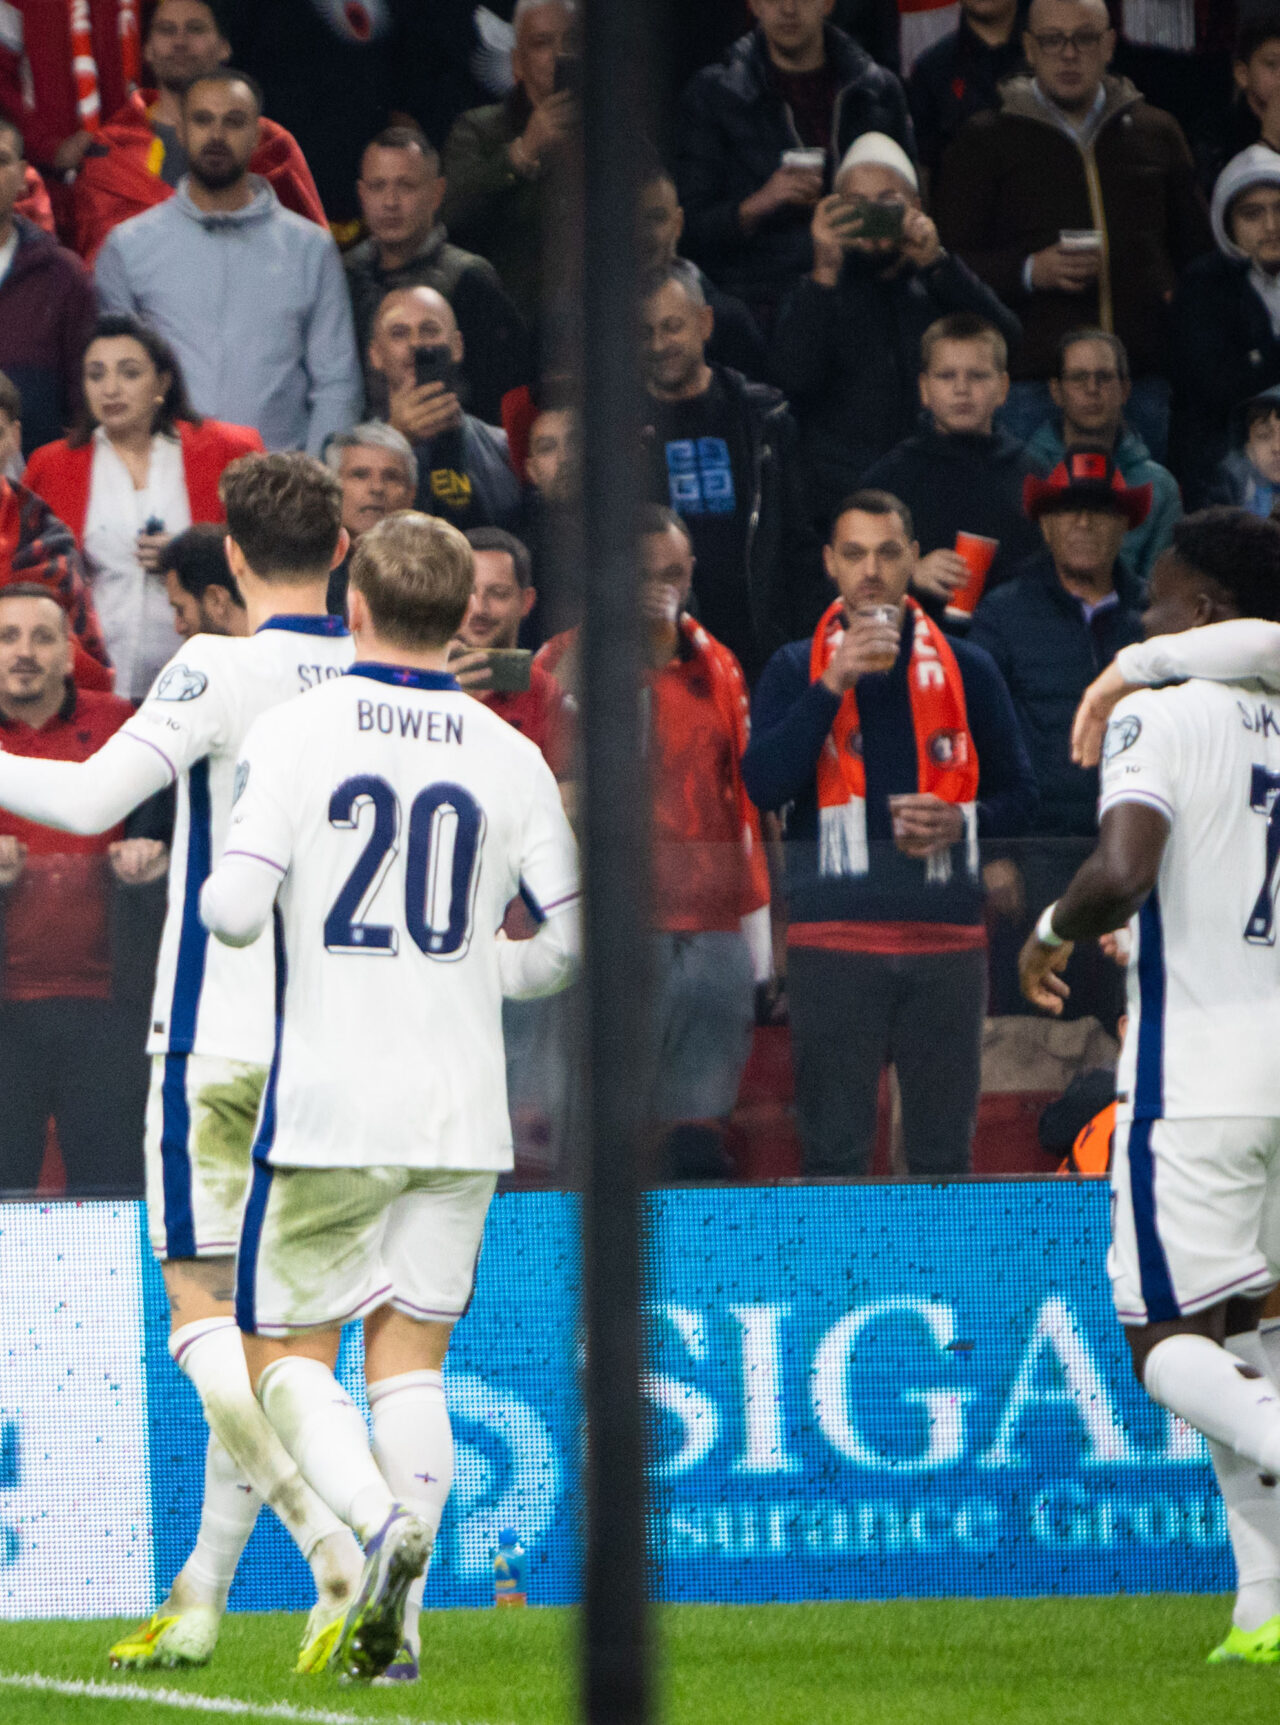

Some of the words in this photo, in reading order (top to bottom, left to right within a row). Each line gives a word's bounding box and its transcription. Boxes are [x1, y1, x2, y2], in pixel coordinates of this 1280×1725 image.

[297, 664, 346, 693] STO
[357, 699, 464, 745] BOWEN
[323, 773, 487, 962] 20
[582, 1293, 1215, 1478] SIGA
[645, 1496, 1000, 1554] surance
[1031, 1478, 1228, 1552] Grou
